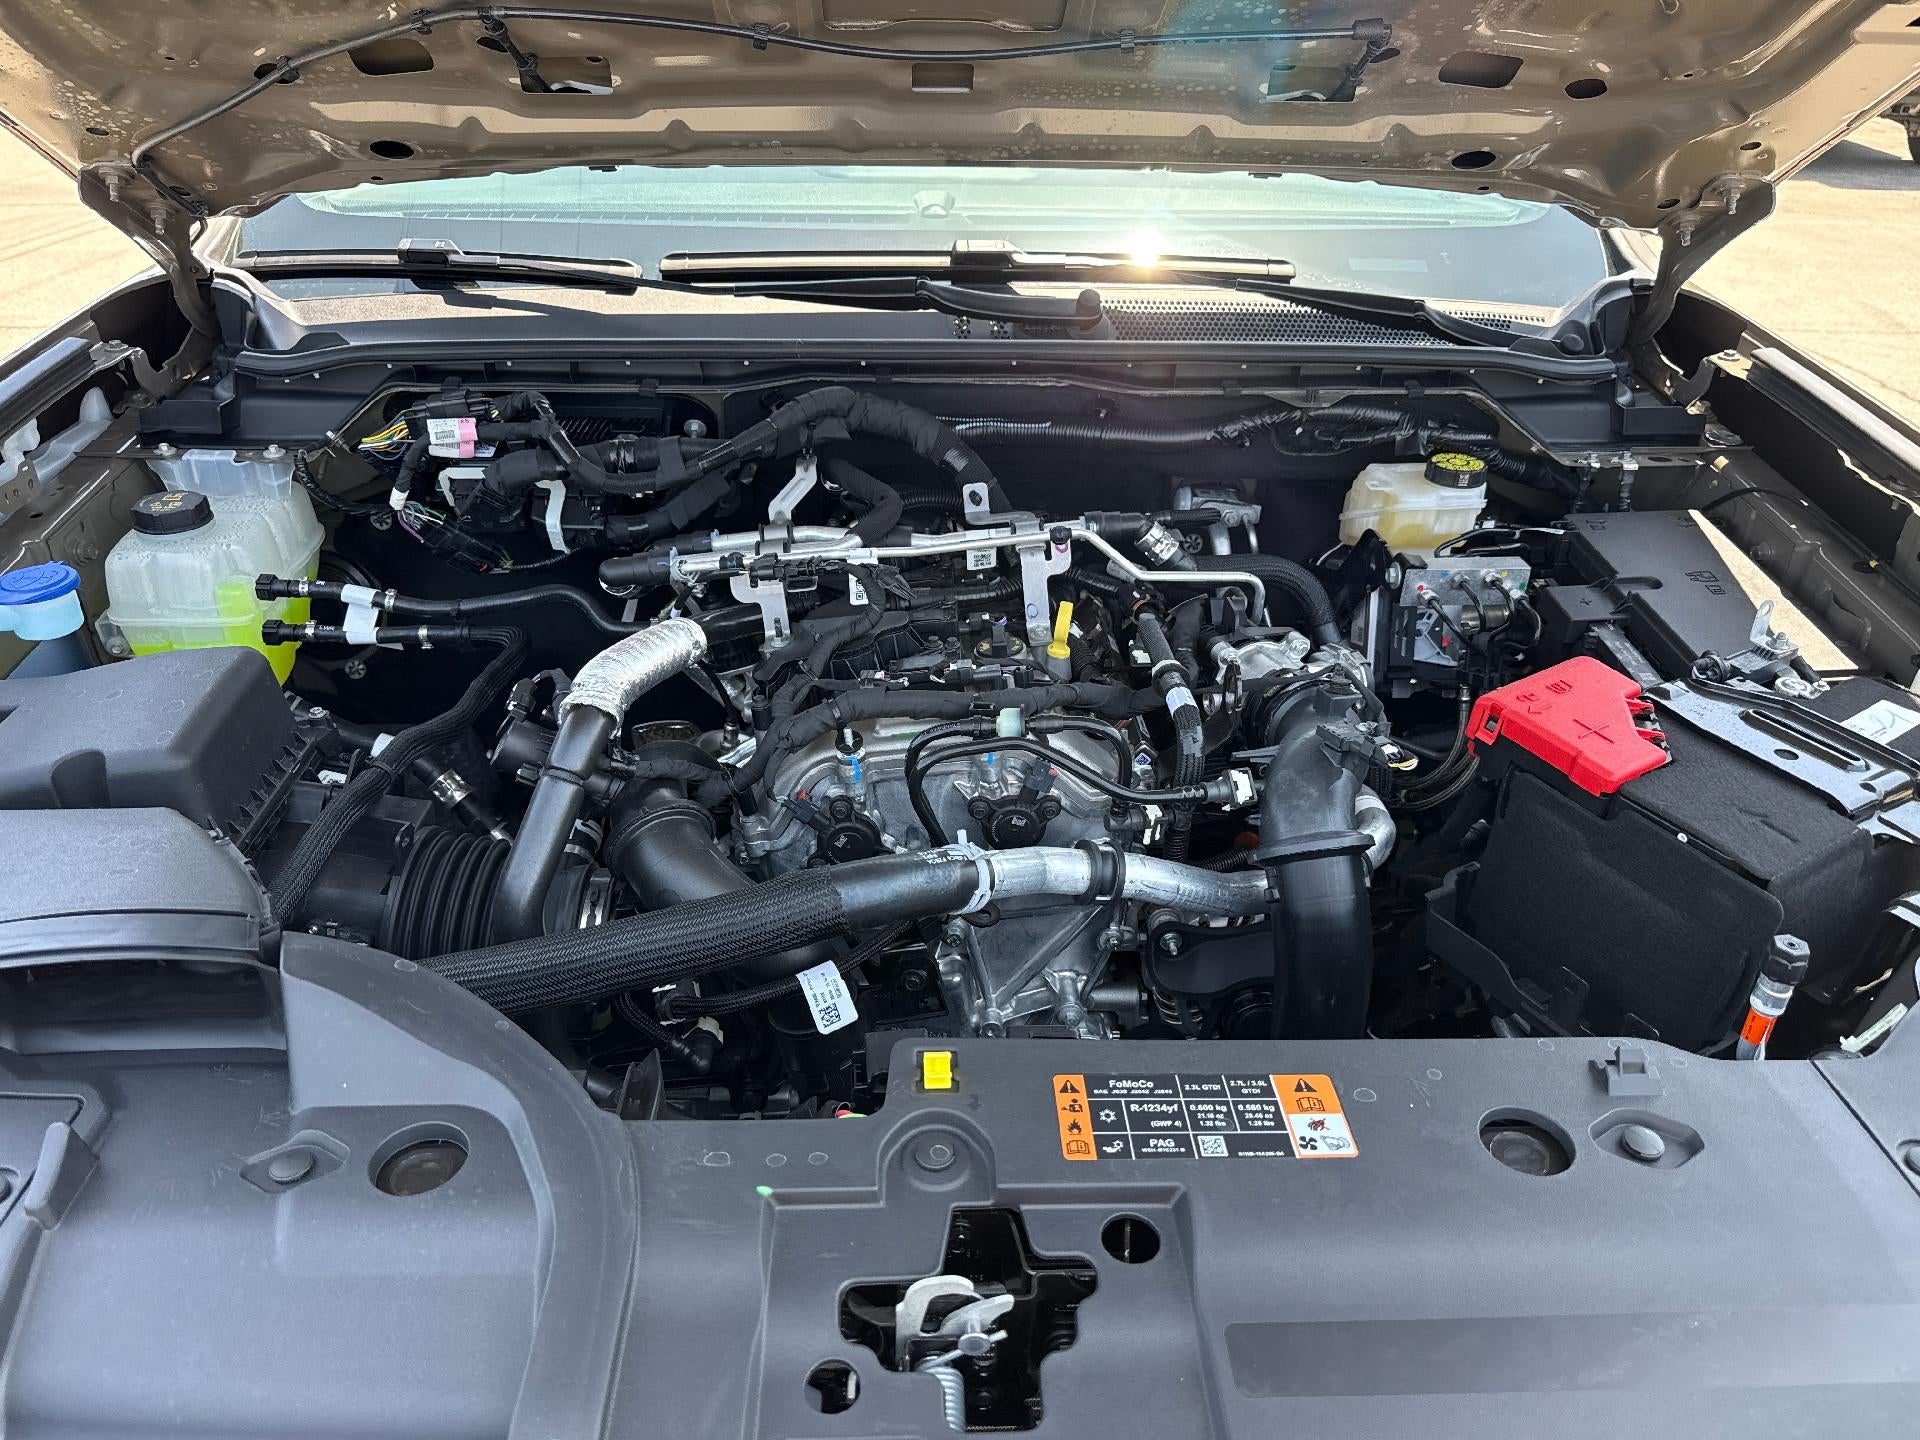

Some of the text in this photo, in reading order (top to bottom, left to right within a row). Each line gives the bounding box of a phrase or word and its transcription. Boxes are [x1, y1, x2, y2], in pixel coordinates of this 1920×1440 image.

[1108, 1079, 1154, 1088] FoMoCo
[1129, 1103, 1179, 1114] R-1234yf
[1189, 1103, 1228, 1113] 0.600 kg
[1237, 1103, 1276, 1113] 0.580 kg
[1150, 1120, 1182, 1128] (GWP 4)
[1149, 1138, 1175, 1147] PAG
